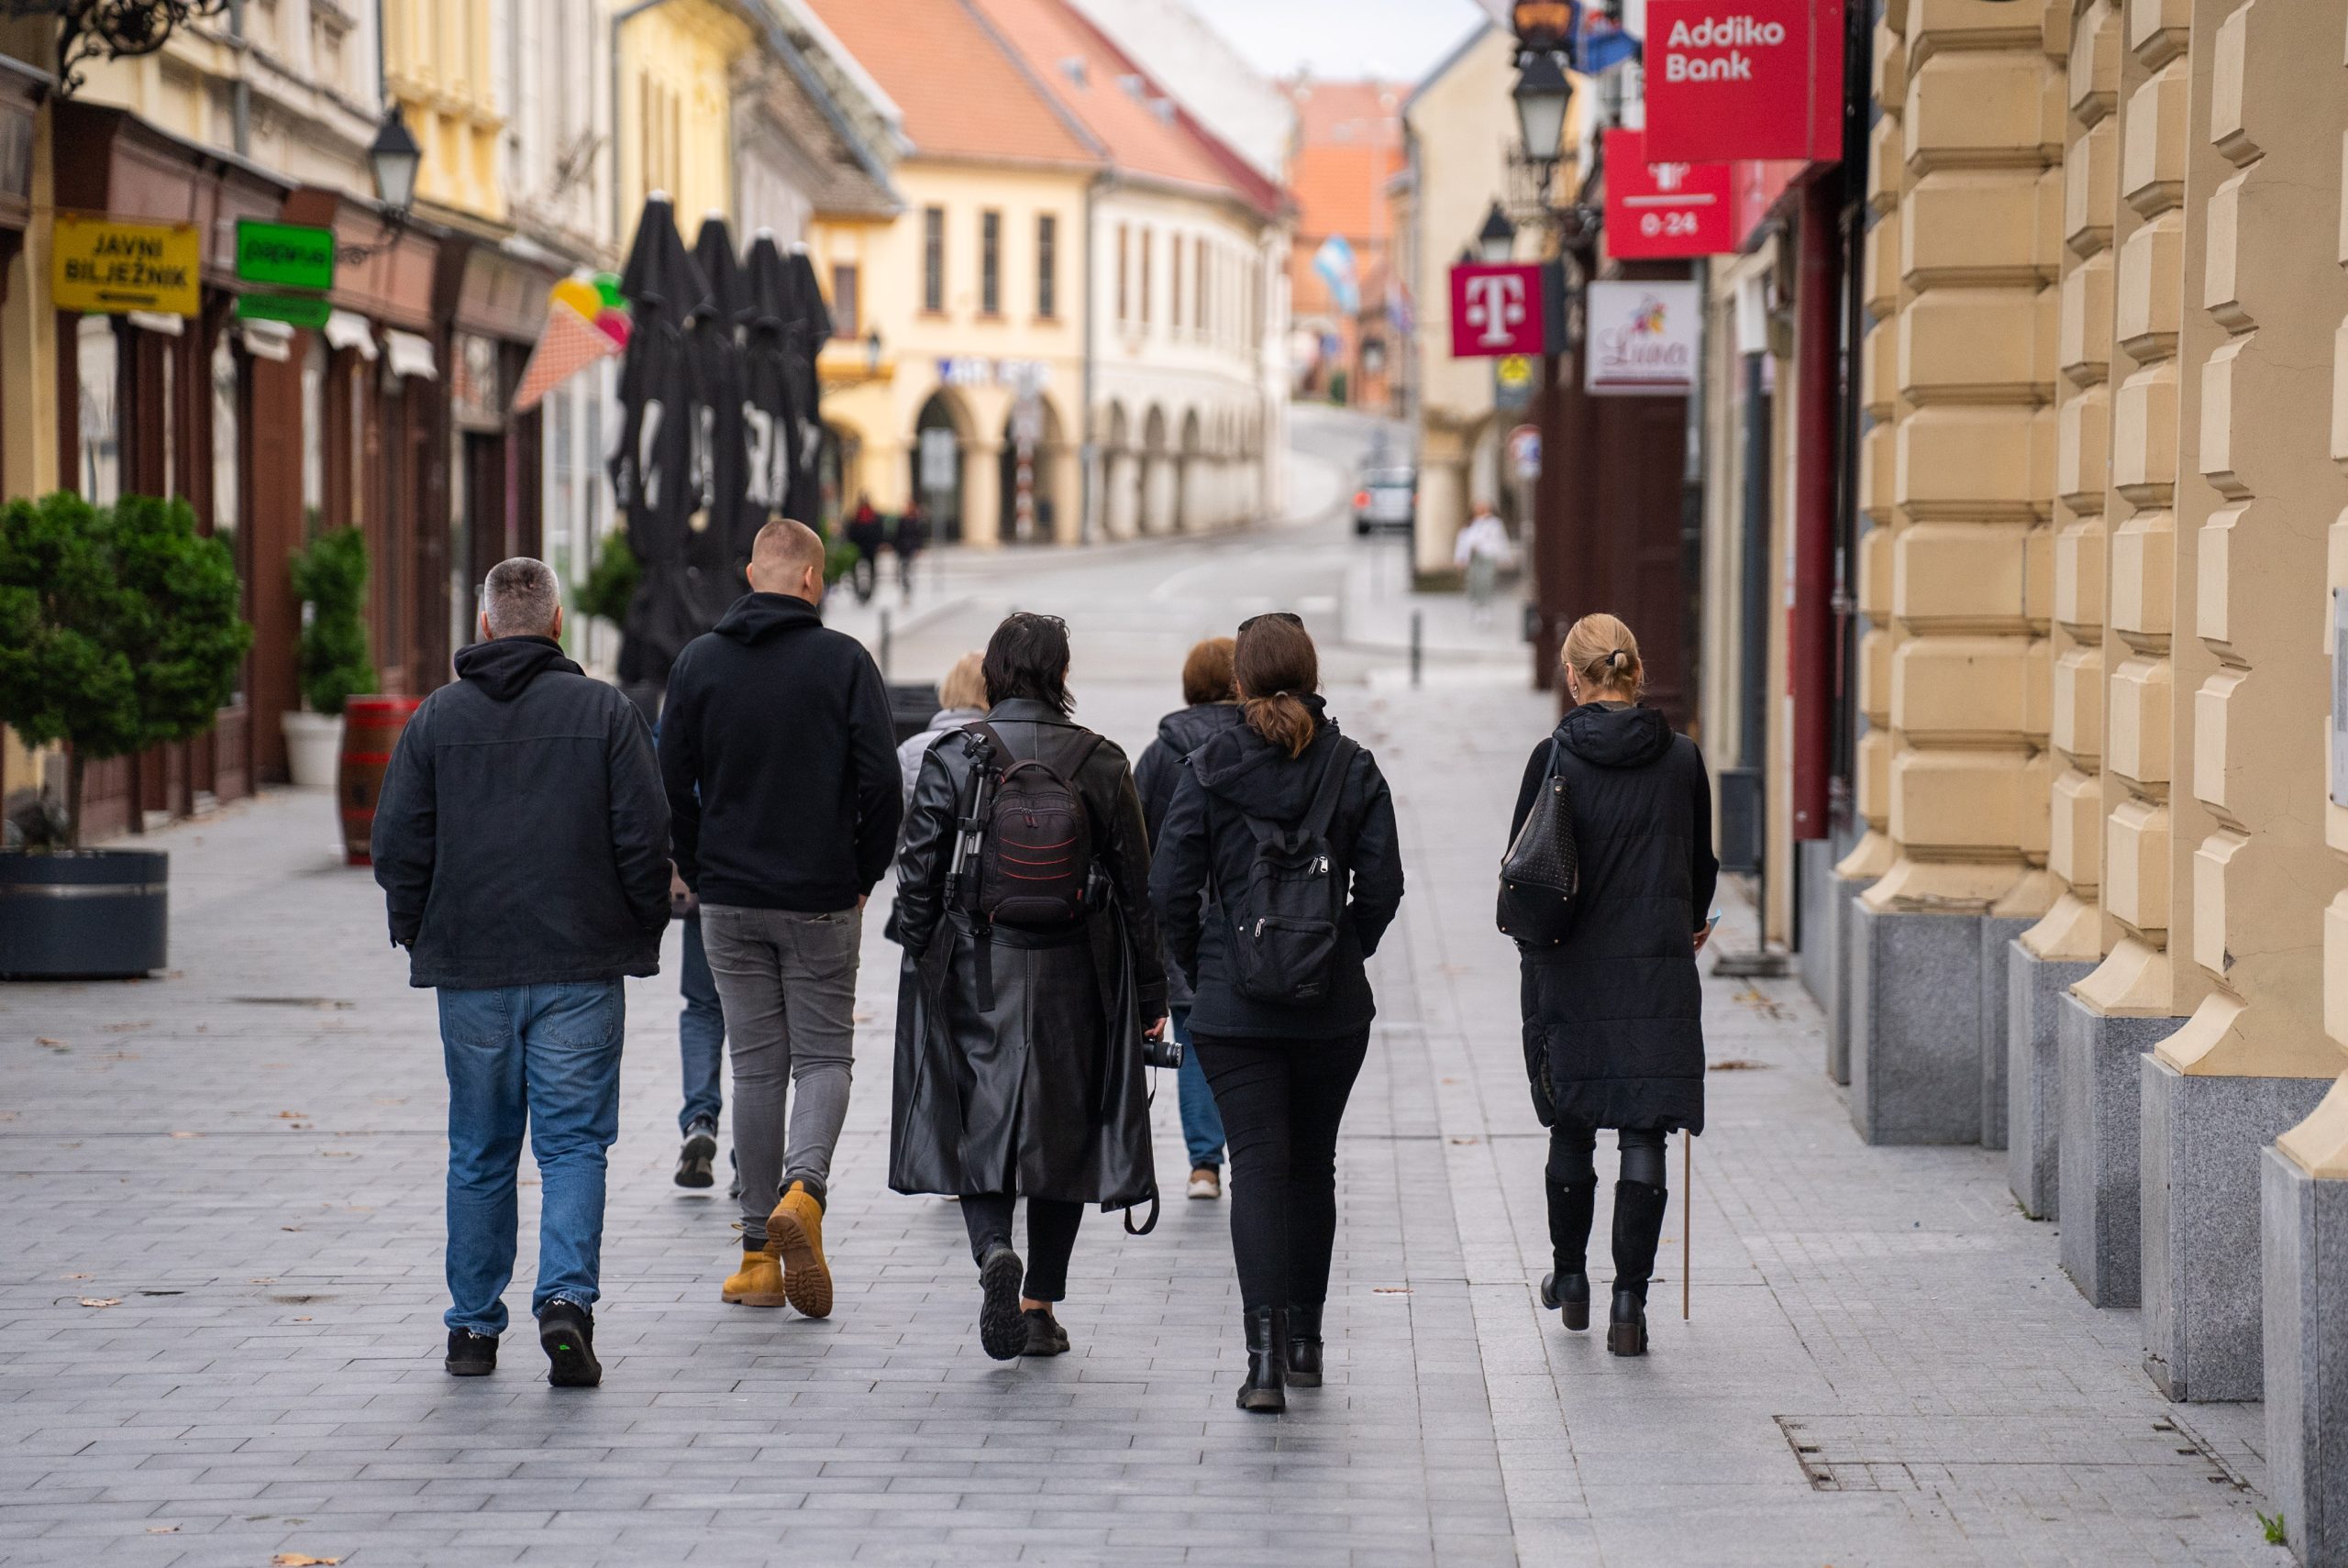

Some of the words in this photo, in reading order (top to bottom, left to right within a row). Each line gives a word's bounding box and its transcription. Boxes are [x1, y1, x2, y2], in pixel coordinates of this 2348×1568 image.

[1667, 15, 1785, 48] Addiko
[1666, 50, 1752, 82] Bank
[93, 234, 163, 258] JAVNI
[65, 258, 188, 290] BILJEŽNIK
[1465, 274, 1526, 348] T
